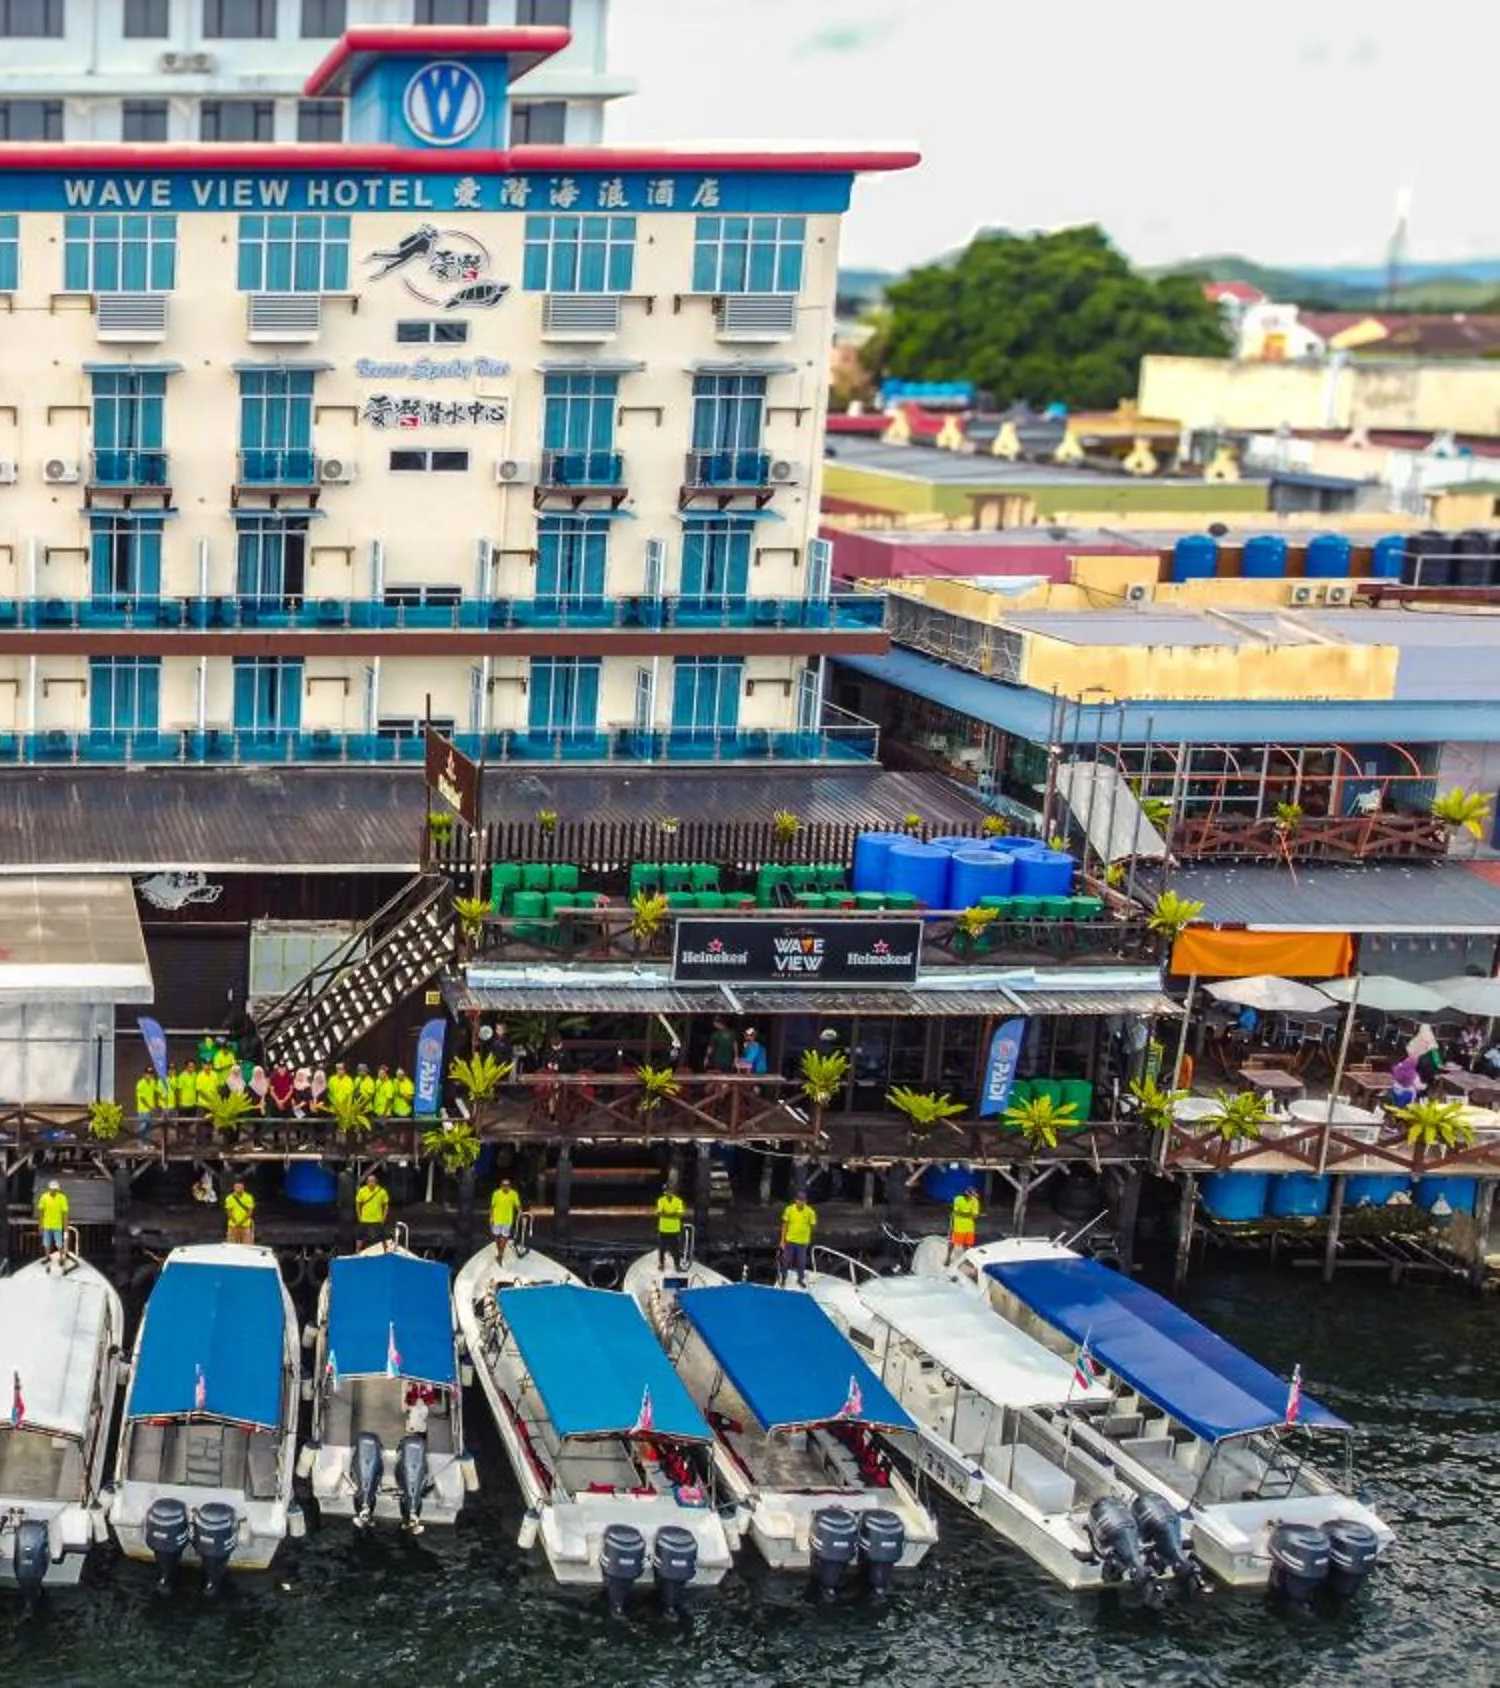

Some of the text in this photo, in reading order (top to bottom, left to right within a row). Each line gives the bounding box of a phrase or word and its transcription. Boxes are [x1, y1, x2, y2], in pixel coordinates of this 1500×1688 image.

[64, 179, 433, 207] WAVE VIEW HOTEL
[773, 937, 826, 954] WAVE
[682, 951, 748, 965] Heineken
[773, 955, 823, 971] VIEW
[847, 951, 913, 966] Heineken
[987, 1060, 1012, 1101] PADI
